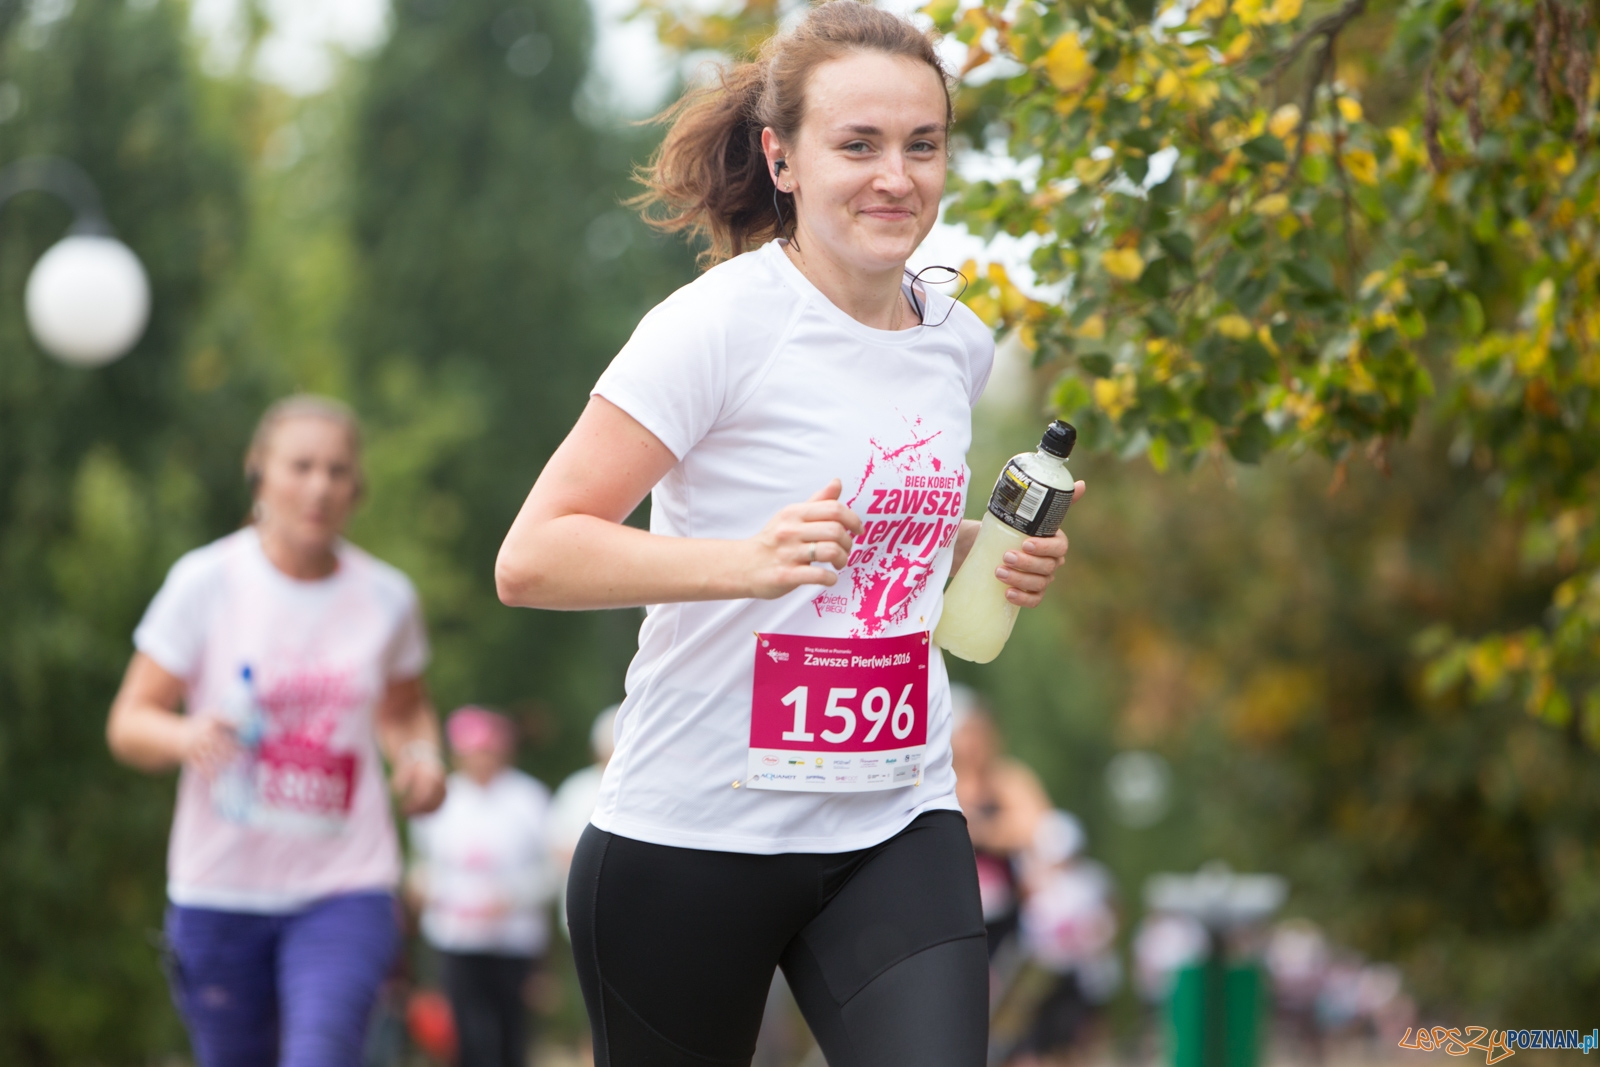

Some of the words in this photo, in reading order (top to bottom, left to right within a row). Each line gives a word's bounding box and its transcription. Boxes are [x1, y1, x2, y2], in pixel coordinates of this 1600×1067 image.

[905, 475, 926, 488] BIEG
[927, 476, 956, 490] KOBIET
[866, 488, 962, 517] zawsze
[849, 516, 963, 558] ier(w)si!
[826, 604, 847, 614] BIEGU
[803, 653, 849, 667] Zawsze
[851, 655, 892, 669] Pier(w)si
[893, 652, 910, 666] 2016
[780, 683, 915, 744] 1596
